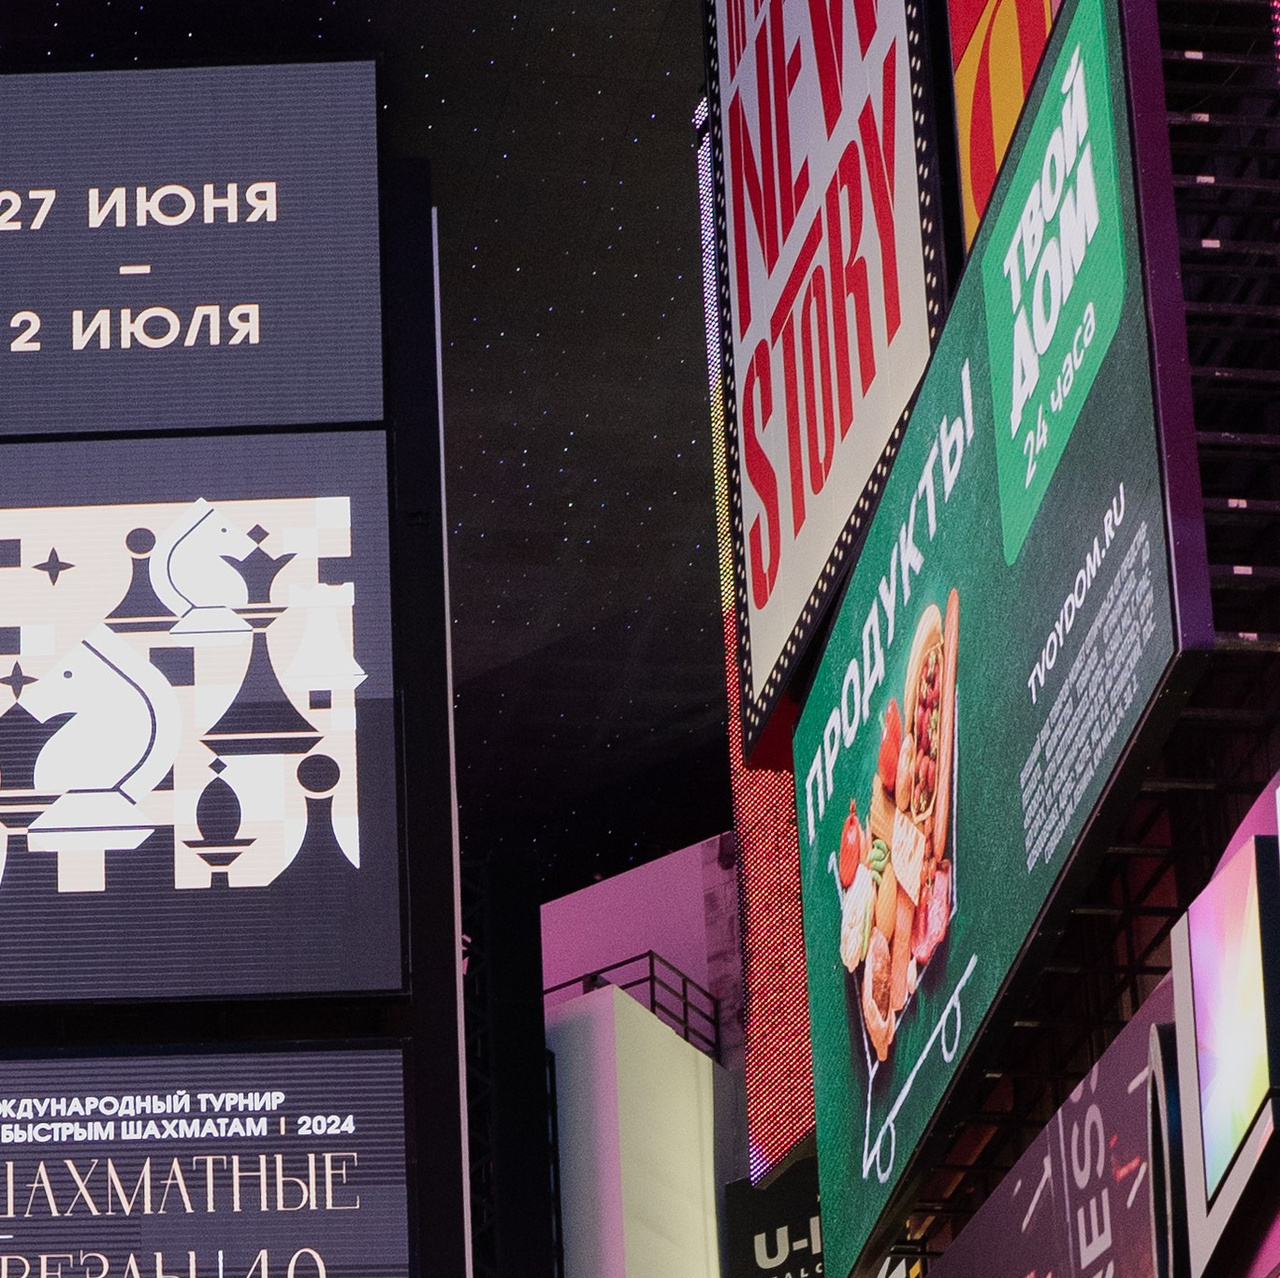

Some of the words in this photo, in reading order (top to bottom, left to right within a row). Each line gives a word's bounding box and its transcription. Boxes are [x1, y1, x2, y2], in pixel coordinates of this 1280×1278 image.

[88, 181, 277, 228] ИЮНЯ
[1002, 42, 1090, 314] ТВОЙ
[9, 311, 41, 352] 2
[72, 304, 260, 351] ИЮЛЯ
[742, 36, 903, 611] STORY
[1023, 404, 1049, 489] 24
[1050, 301, 1097, 413] часа
[804, 356, 977, 846] ПРОДУКТЫ
[1027, 482, 1127, 704] TVOYDOM.RU
[0, 1121, 115, 1144] БЫСТРЫМ
[120, 1116, 268, 1140] ШАХМАТАМ
[297, 1114, 356, 1136] 2024
[196, 1091, 286, 1113] ТУРНИР
